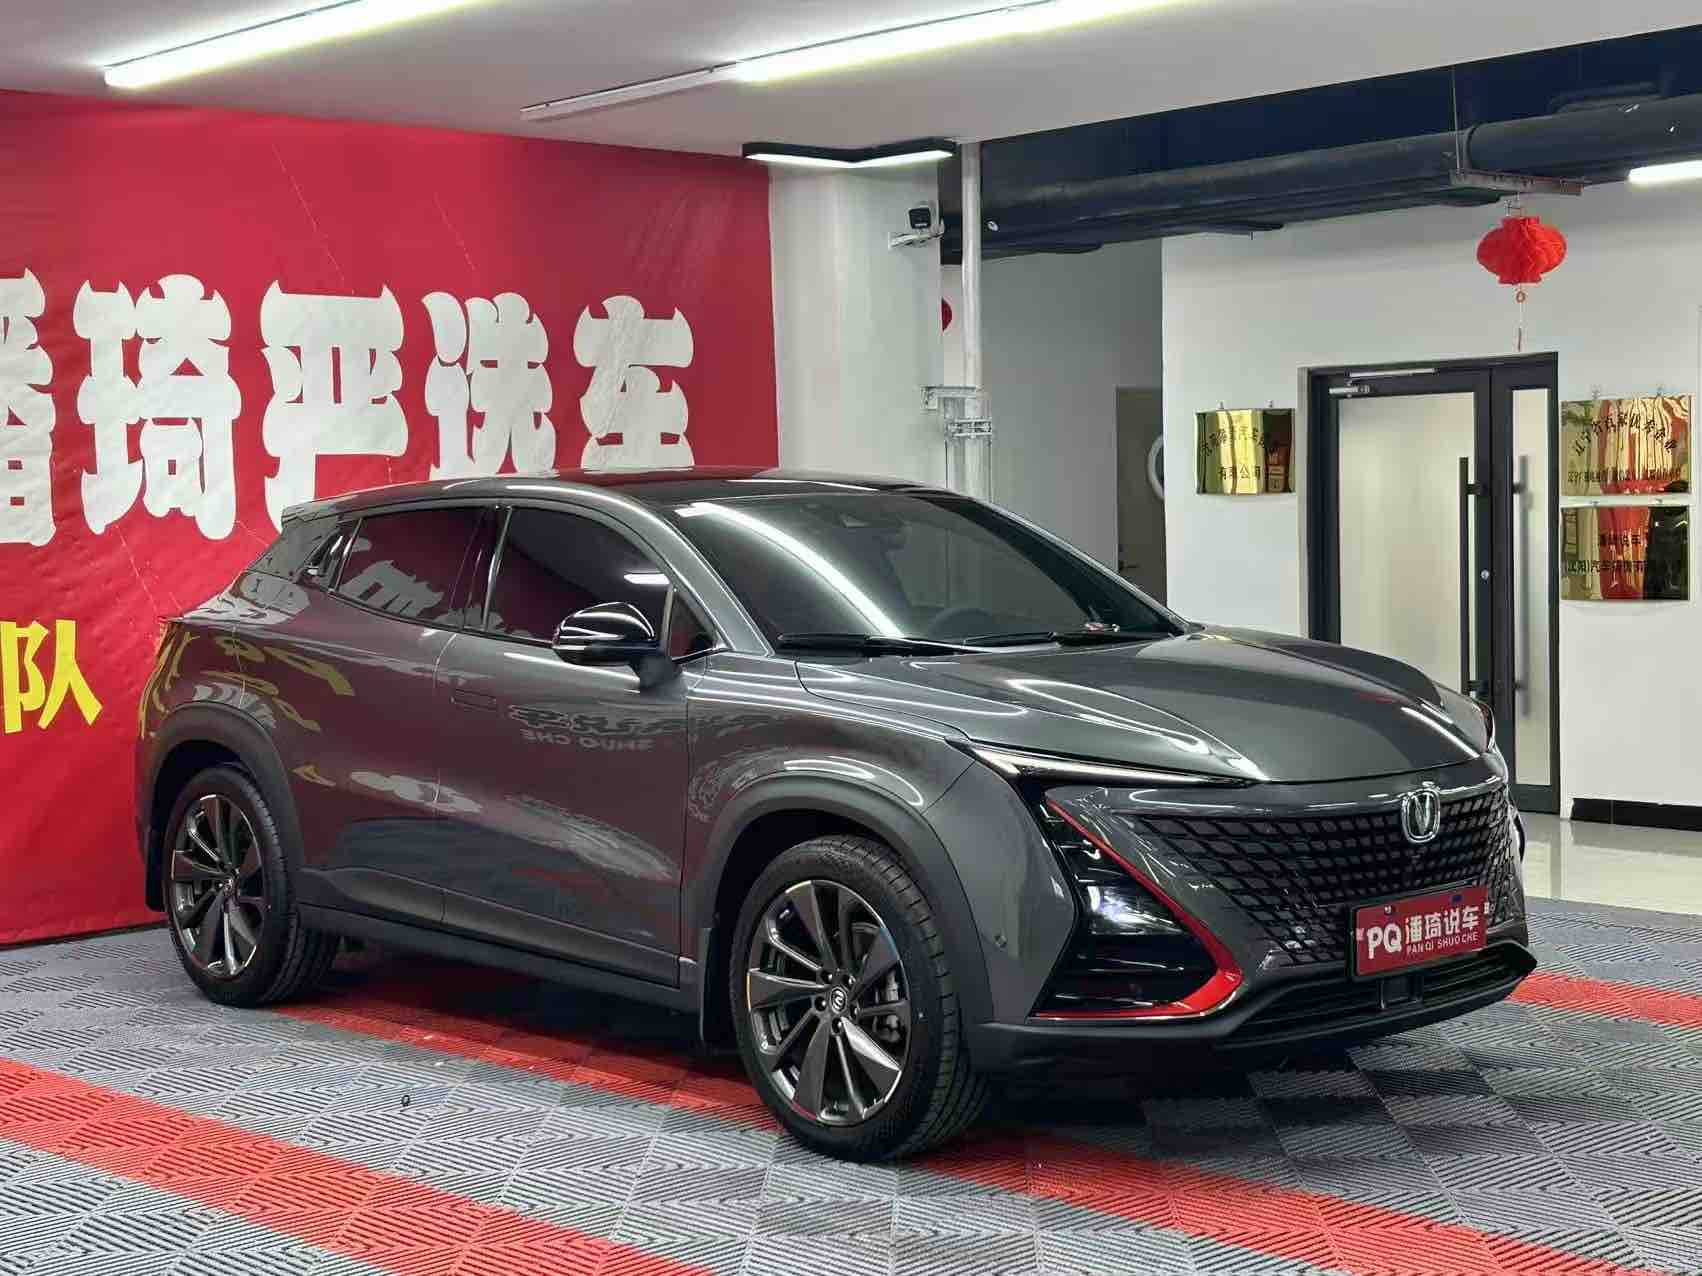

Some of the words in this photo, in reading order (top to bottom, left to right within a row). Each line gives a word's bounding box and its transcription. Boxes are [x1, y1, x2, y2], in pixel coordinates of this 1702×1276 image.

[0, 619, 103, 734] 队
[1366, 923, 1402, 960] PQ
[1405, 905, 1479, 944] 潘琦说车
[1406, 943, 1424, 956] PAN
[1438, 935, 1460, 949] SHUO
[1461, 931, 1479, 943] CHE
